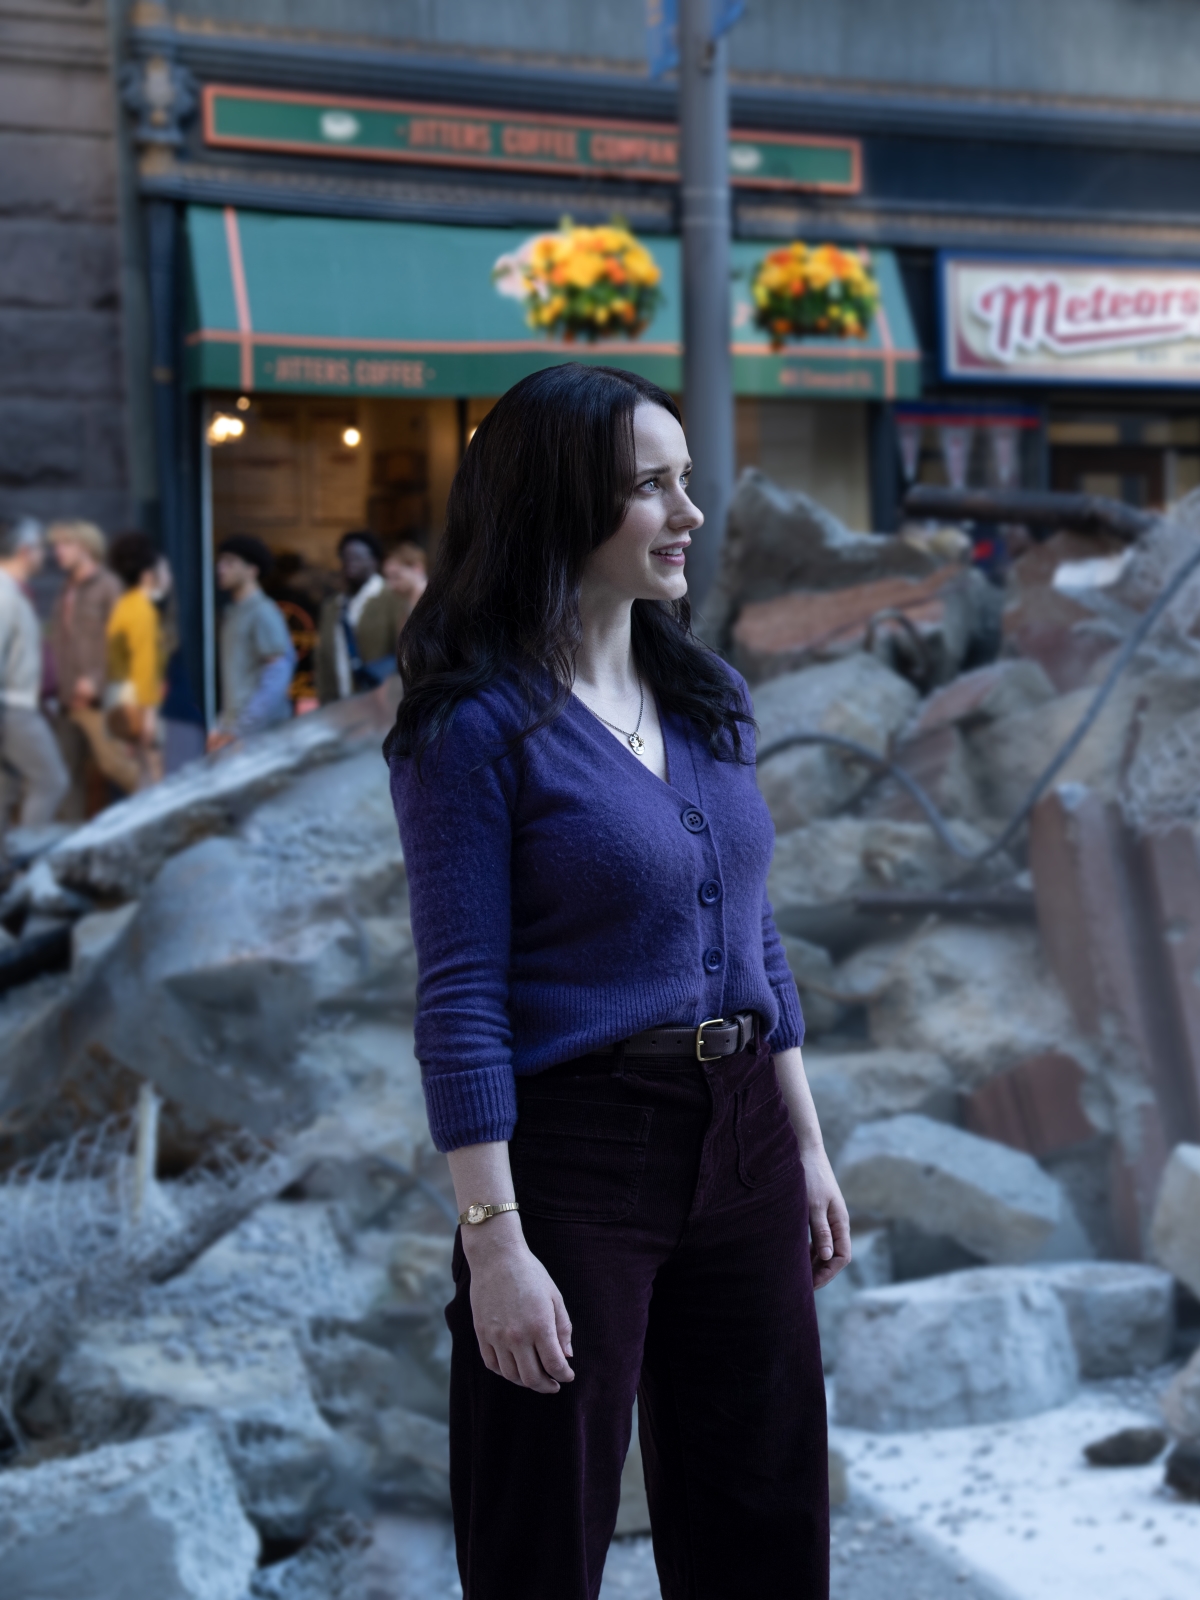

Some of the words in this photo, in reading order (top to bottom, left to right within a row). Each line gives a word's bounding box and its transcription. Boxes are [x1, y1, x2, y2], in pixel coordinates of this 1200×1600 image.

[501, 125, 578, 160] COFFEE
[589, 133, 681, 166] COMPAN
[354, 357, 426, 389] COFFEE
